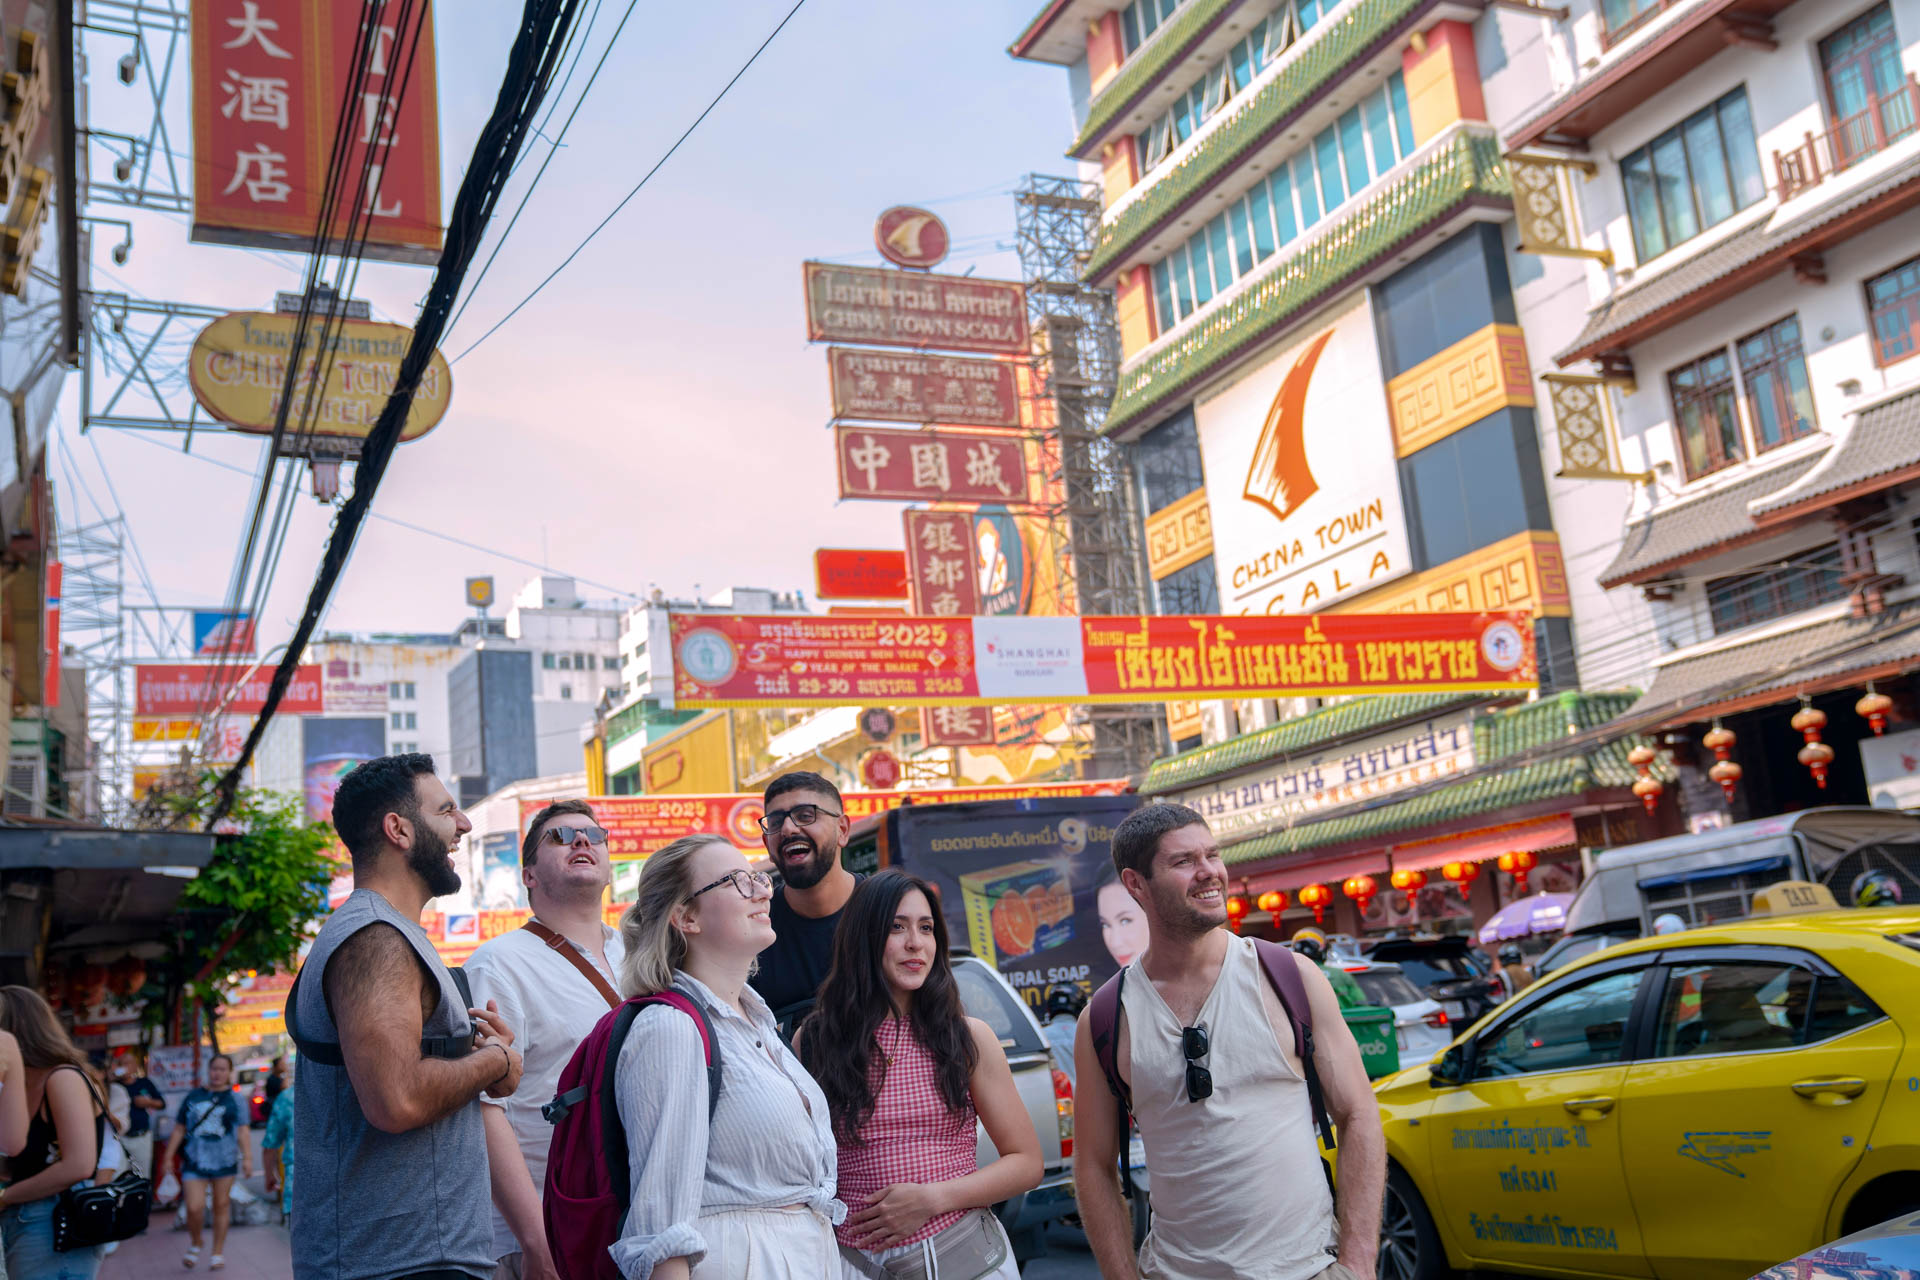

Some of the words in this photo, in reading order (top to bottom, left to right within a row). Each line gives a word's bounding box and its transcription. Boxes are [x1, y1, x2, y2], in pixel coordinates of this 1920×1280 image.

[221, 0, 293, 203] 大酒店
[823, 309, 886, 331] CHINA
[890, 314, 951, 338] TOWN
[955, 319, 1018, 343] SCALA
[850, 435, 1011, 496] 中國城
[1232, 540, 1304, 589] CHINA
[1314, 498, 1384, 549] TOWN
[1240, 551, 1390, 616] CALA
[878, 623, 948, 647] 2025
[997, 648, 1071, 658] SHANGHAI
[1355, 640, 1479, 683] เยาวราช
[861, 663, 880, 673] THE
[658, 800, 707, 818] 2025
[1058, 818, 1087, 855] 9
[1782, 886, 1819, 907] TAXI
[1002, 968, 1045, 988] URAL
[1047, 965, 1090, 984] SOAP
[1360, 1038, 1387, 1056] rab
